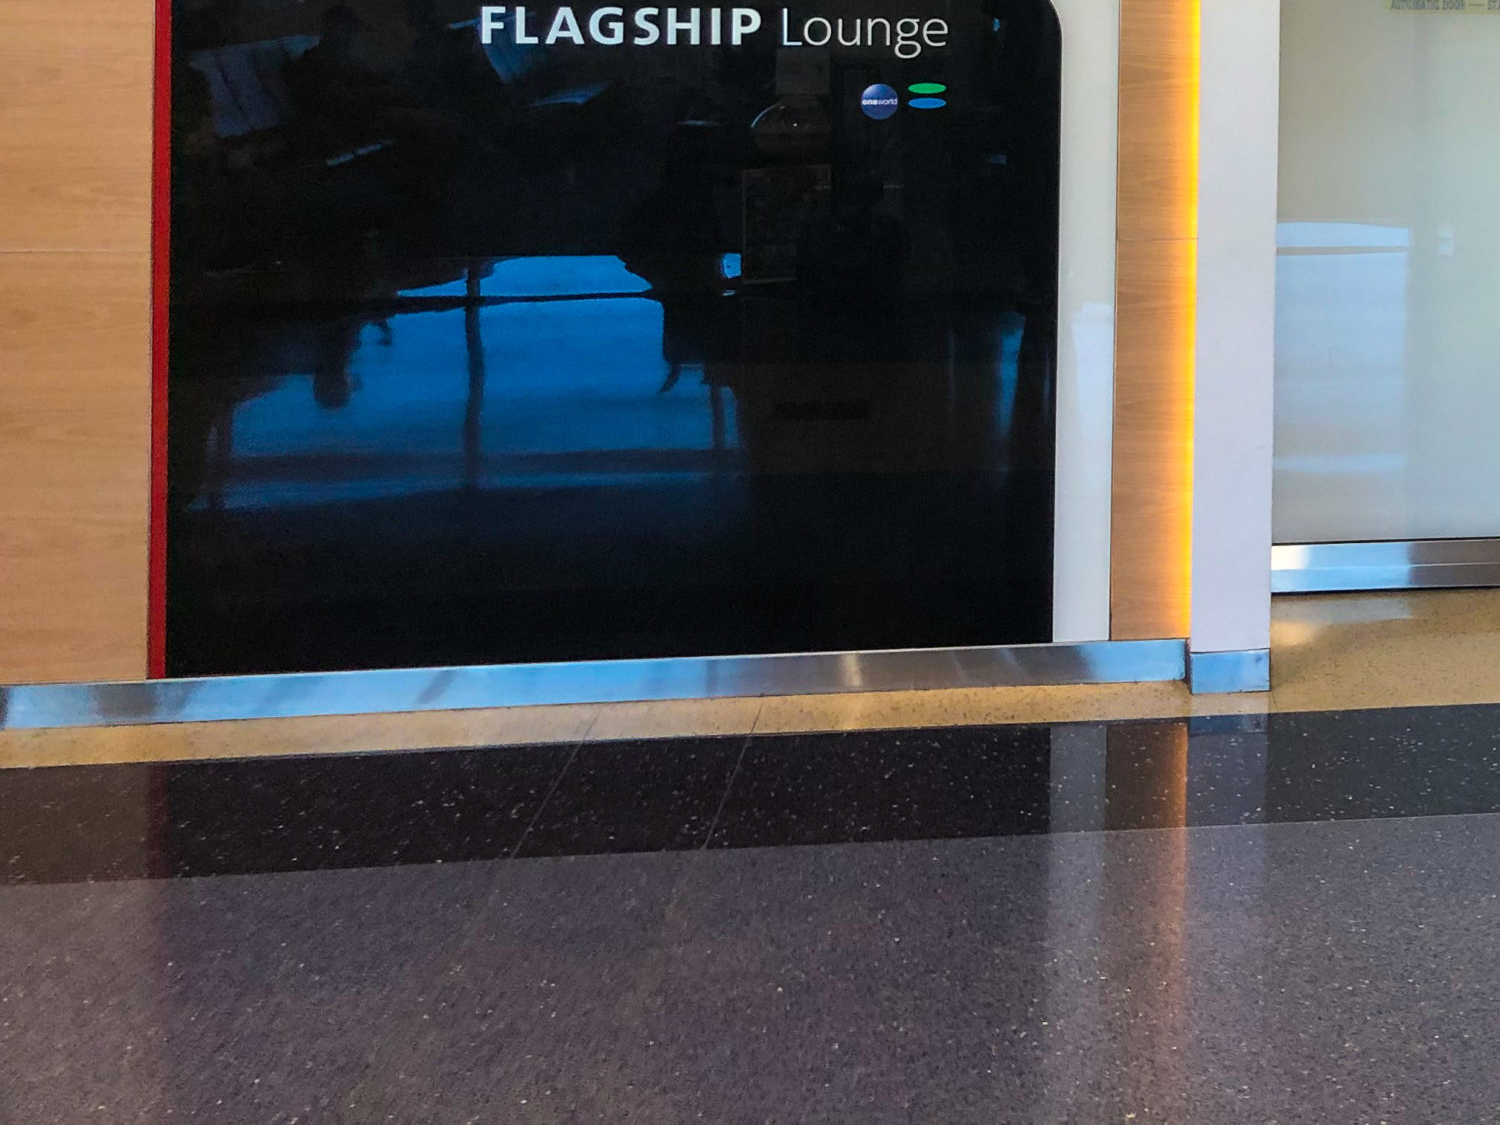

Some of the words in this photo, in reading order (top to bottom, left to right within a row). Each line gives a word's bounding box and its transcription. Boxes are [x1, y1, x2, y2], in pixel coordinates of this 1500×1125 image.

[1390, 0, 1440, 11] AUTOMATIC
[1442, 0, 1466, 11] DOOR
[480, 6, 762, 46] FLAGSHIP
[781, 8, 949, 59] Lounge
[861, 98, 898, 106] oneworld
